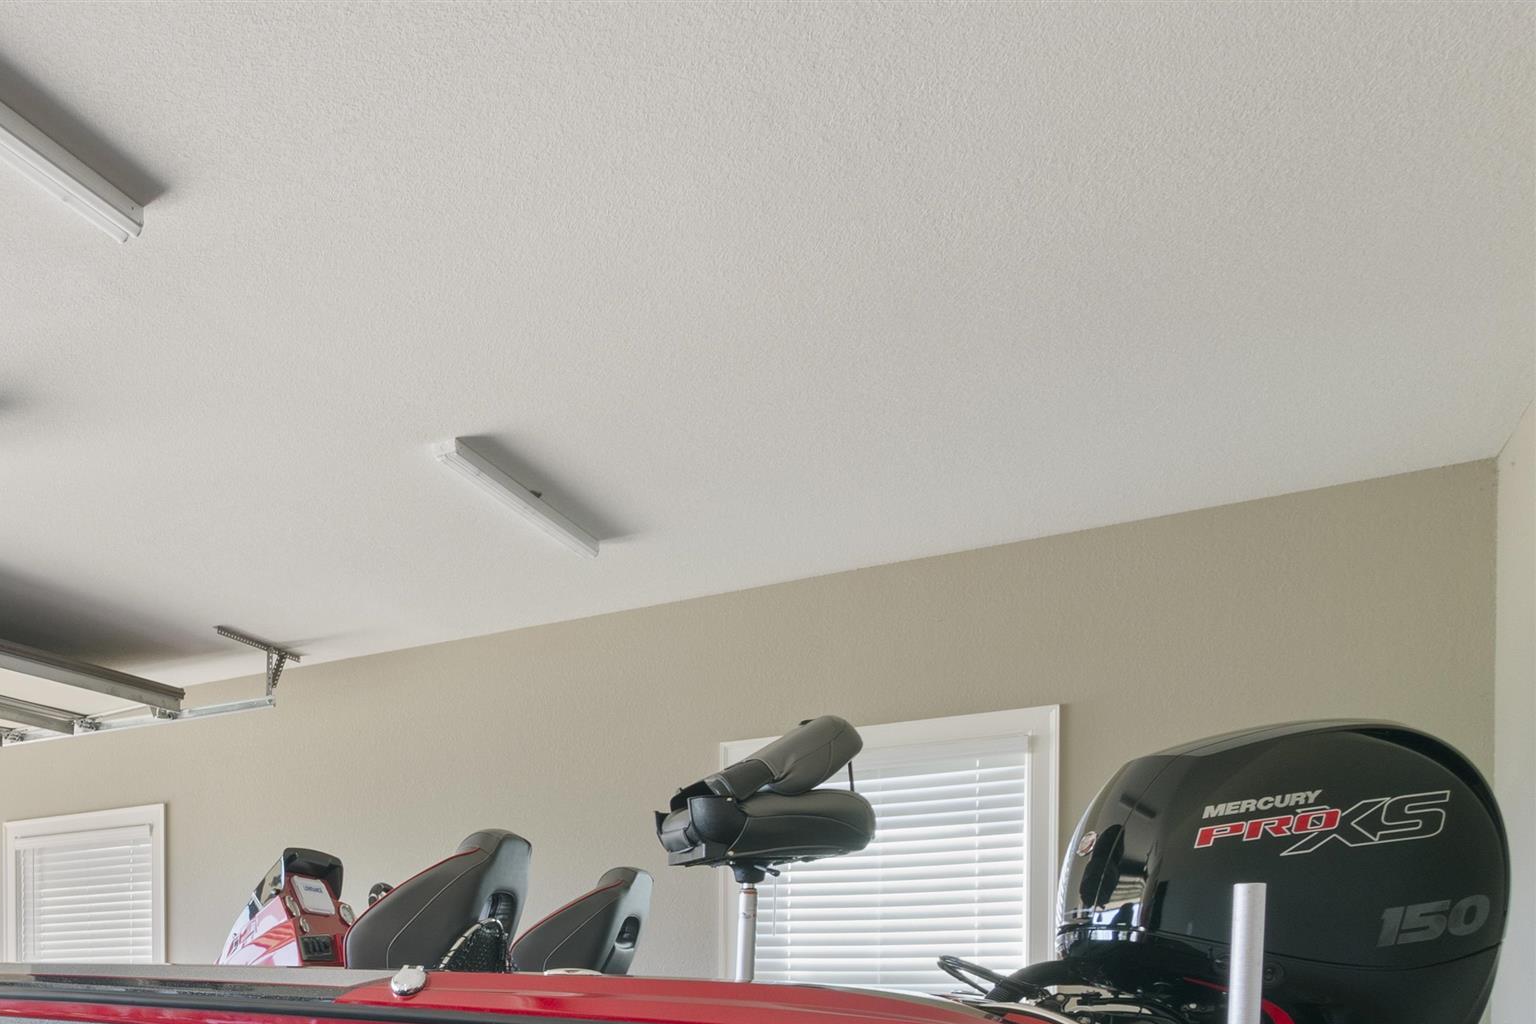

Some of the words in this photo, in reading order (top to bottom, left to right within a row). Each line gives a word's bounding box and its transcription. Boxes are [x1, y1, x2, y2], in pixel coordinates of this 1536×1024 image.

[1194, 808, 1342, 848] PRO
[1280, 790, 1450, 856] XS
[1203, 790, 1322, 819] MERCURY
[1376, 894, 1491, 947] 150
